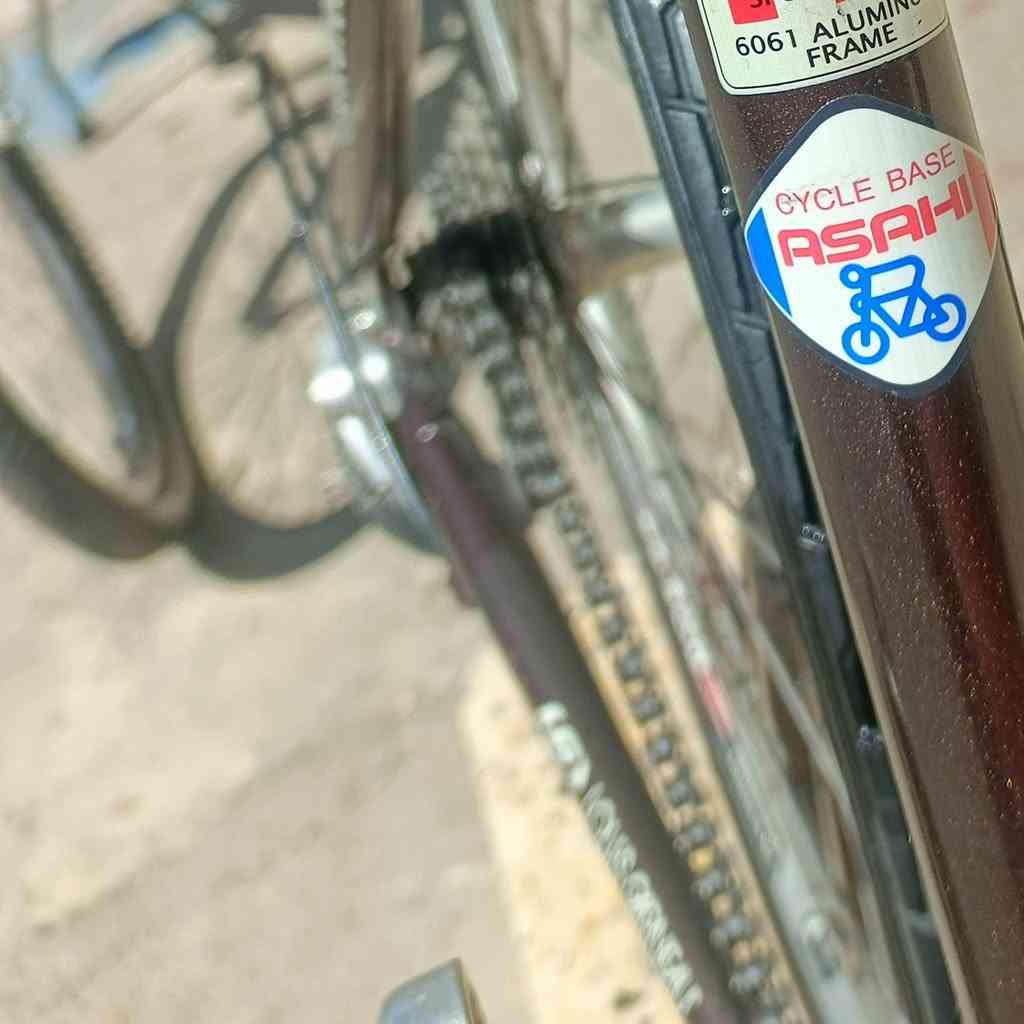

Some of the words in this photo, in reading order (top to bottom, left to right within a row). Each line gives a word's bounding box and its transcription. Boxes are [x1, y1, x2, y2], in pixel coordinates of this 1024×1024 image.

[735, 29, 798, 57] 6061
[806, 21, 898, 68] FRAME
[775, 177, 876, 215] CYCLE
[886, 143, 956, 193] BASE
[777, 173, 974, 268] ASAHI
